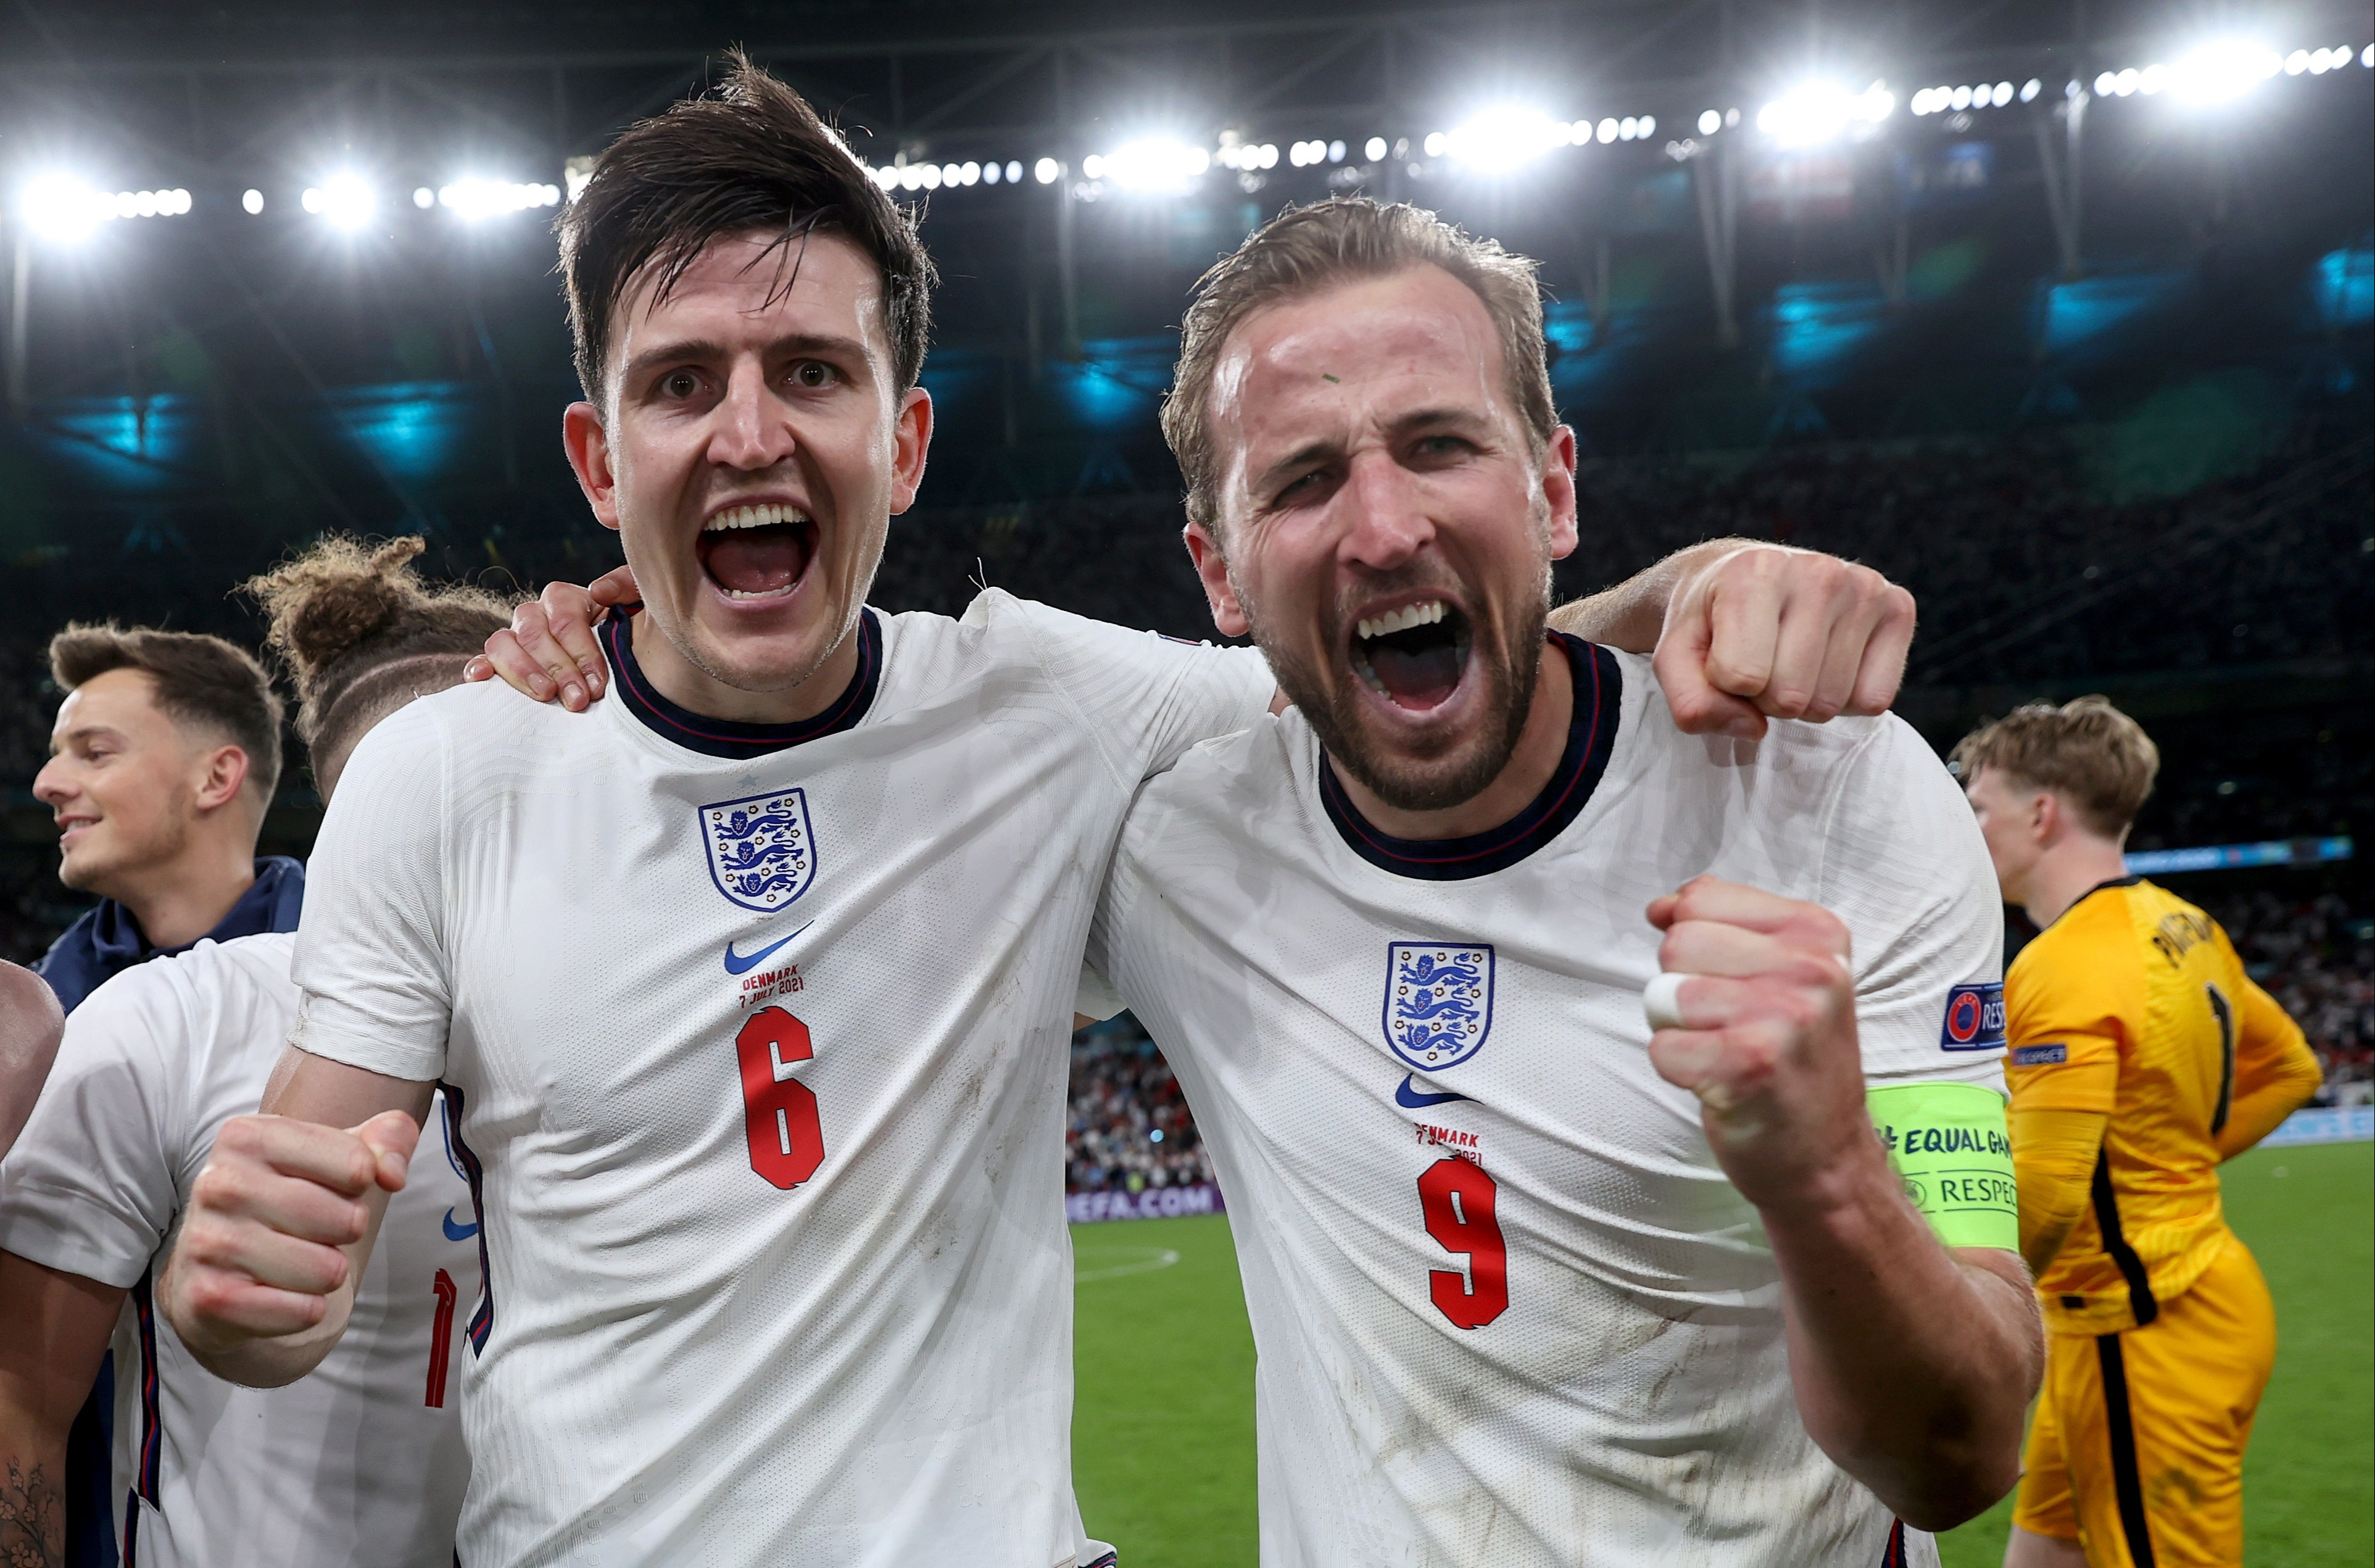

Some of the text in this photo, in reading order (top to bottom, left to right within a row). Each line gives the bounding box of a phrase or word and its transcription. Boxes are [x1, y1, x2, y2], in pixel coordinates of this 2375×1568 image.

[743, 964, 798, 991] DENMARK
[739, 977, 804, 1008] 7 JULY 2021
[1983, 1002, 2005, 1030] RES
[736, 1006, 825, 1190] 6
[1414, 1122, 1479, 1148] ENMARK
[1416, 1130, 1423, 1144] 7
[1417, 1155, 1509, 1330] 9
